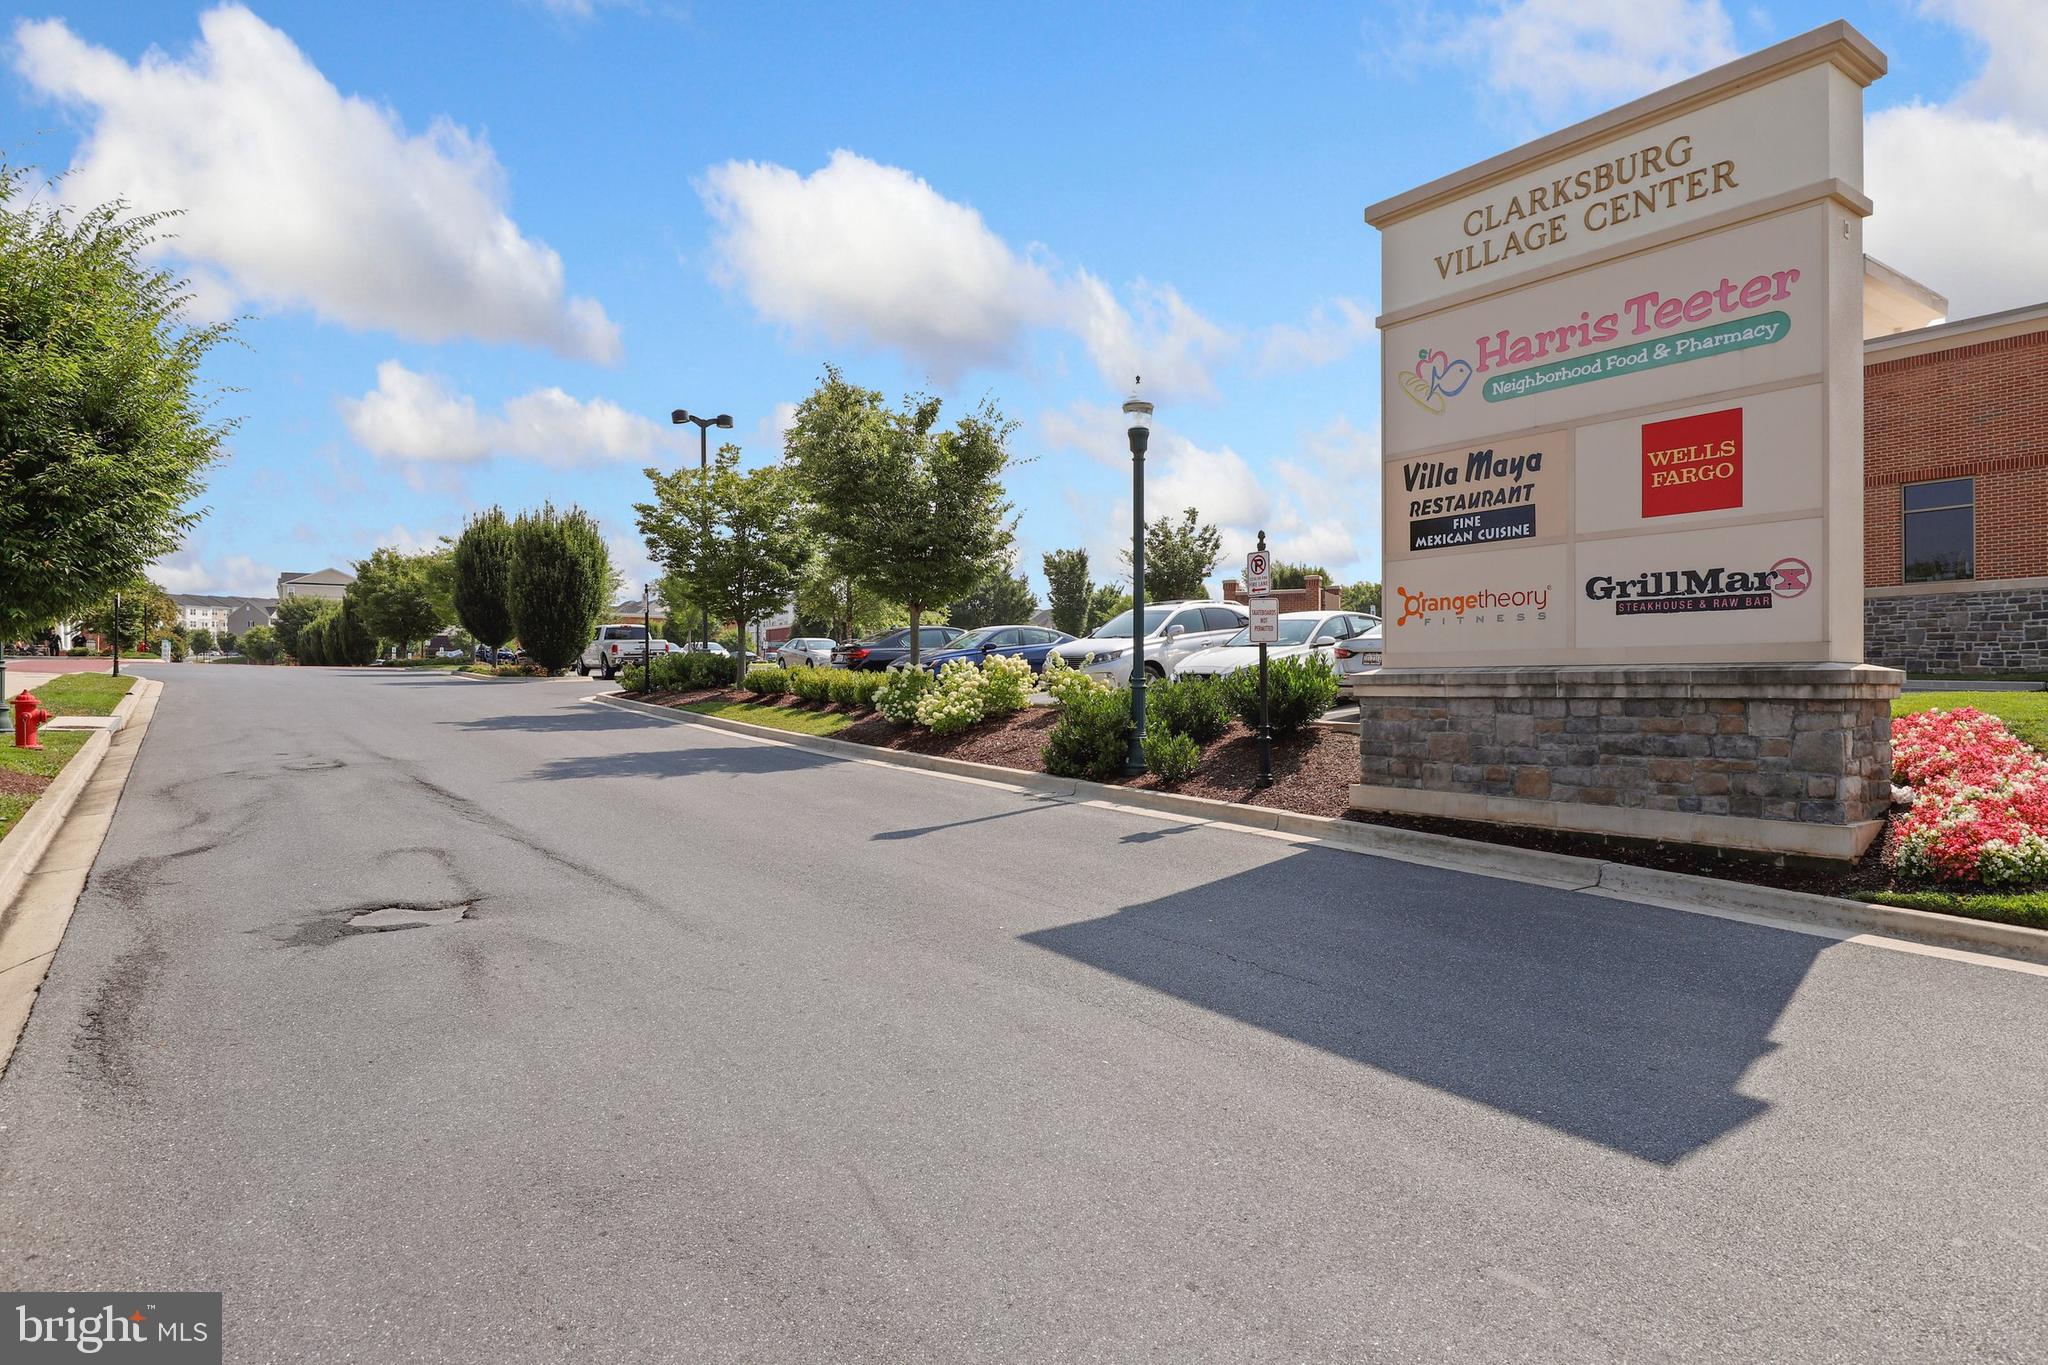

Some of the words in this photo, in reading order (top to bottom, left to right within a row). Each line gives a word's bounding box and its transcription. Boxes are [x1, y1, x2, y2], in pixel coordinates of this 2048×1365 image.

[1463, 134, 1694, 238] CLARKSBURG
[1433, 214, 1567, 281] VILLAGE
[1583, 158, 1739, 233] CENTER
[1475, 310, 1619, 374] Harris
[1624, 267, 1801, 337] Teeter
[1491, 358, 1603, 400] Neighborhood
[1606, 347, 1649, 372] Food
[1652, 343, 1671, 361] &
[1675, 320, 1780, 358] Pharmacy
[1647, 438, 1736, 467] WELLS
[1403, 458, 1458, 493] Villa
[1464, 449, 1543, 483] Maya
[1651, 461, 1735, 488] FARGO
[1409, 483, 1535, 518] RESTAURANT
[1415, 530, 1473, 549] MEXICAN
[1477, 523, 1530, 541] CUISINE
[1452, 515, 1481, 531] FINE
[1618, 600, 1693, 612] STEAKHOUSE
[1699, 600, 1706, 608] &
[1713, 598, 1739, 608] RAW
[1746, 596, 1771, 607] BAR
